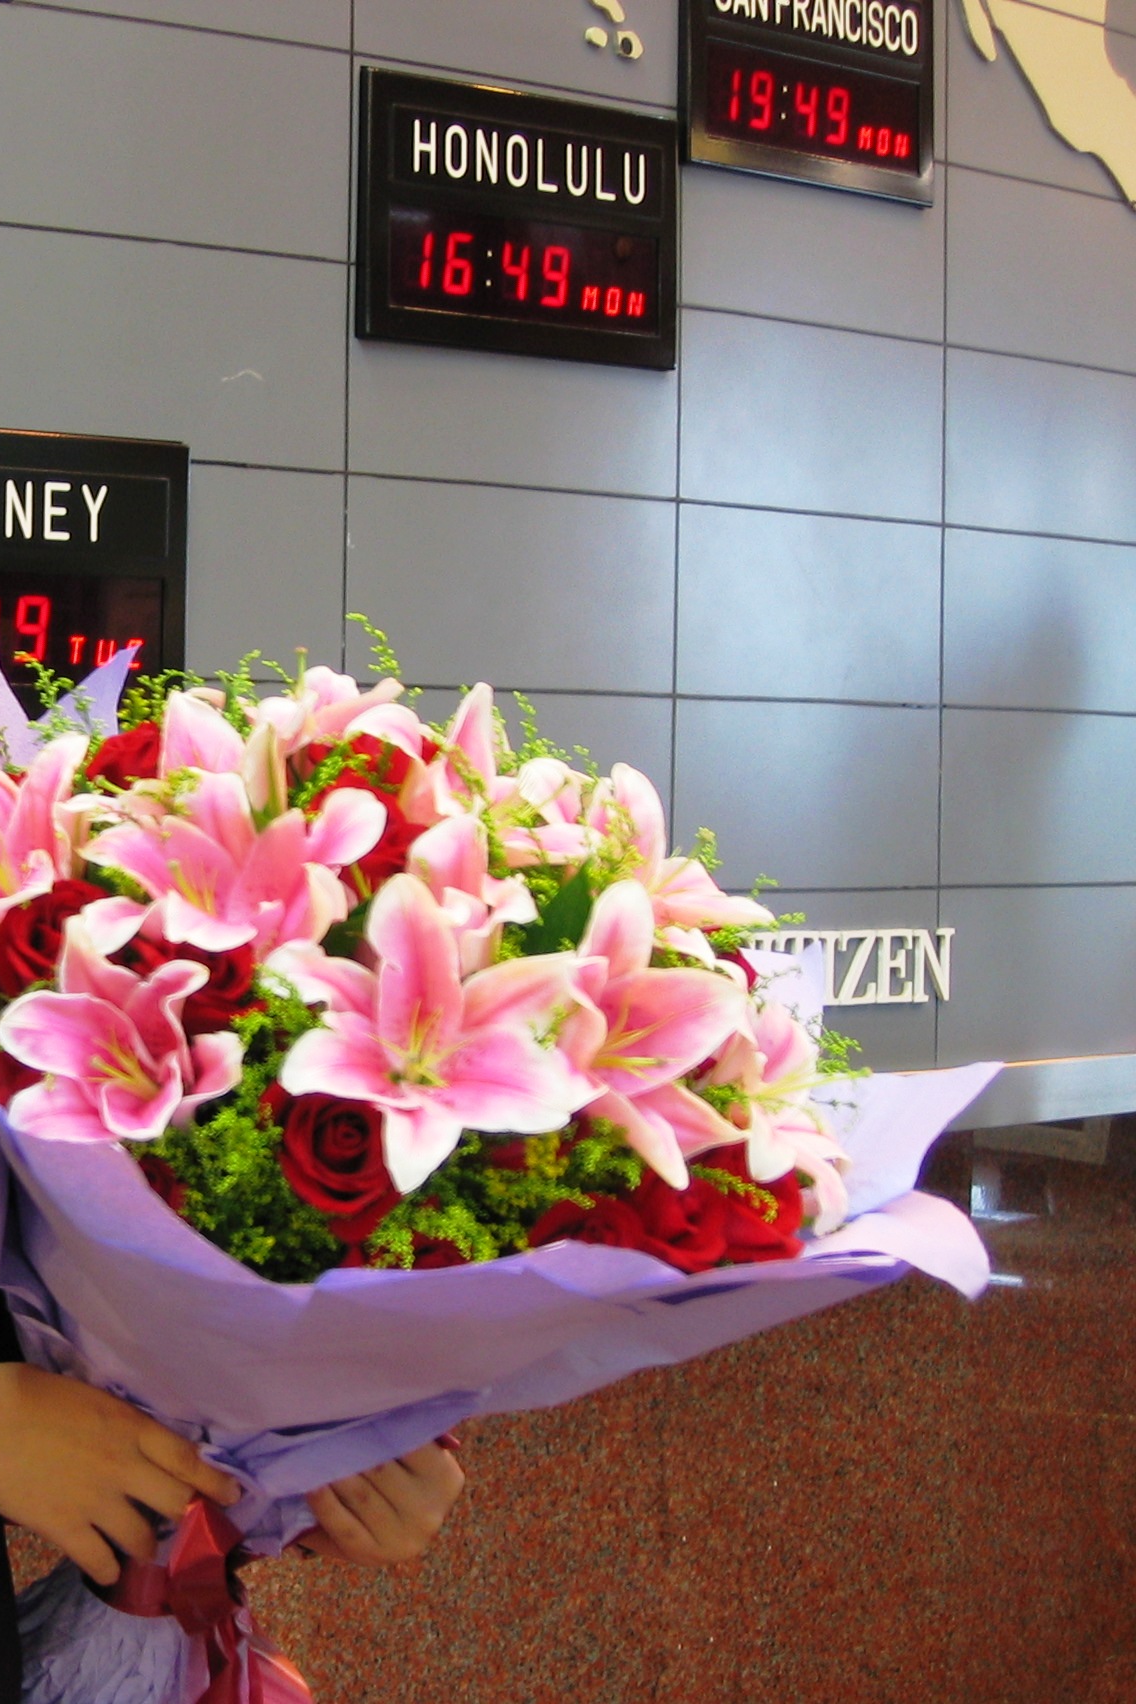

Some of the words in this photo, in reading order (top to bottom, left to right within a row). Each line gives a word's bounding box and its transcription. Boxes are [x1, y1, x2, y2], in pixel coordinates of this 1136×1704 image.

[774, 0, 918, 56] FRANCISCO
[727, 69, 849, 146] 19:49
[857, 125, 910, 158] MON
[412, 119, 647, 205] HONOLULU
[418, 231, 570, 308] 16:49
[581, 284, 646, 318] MON
[748, 927, 955, 1006] IZEN
